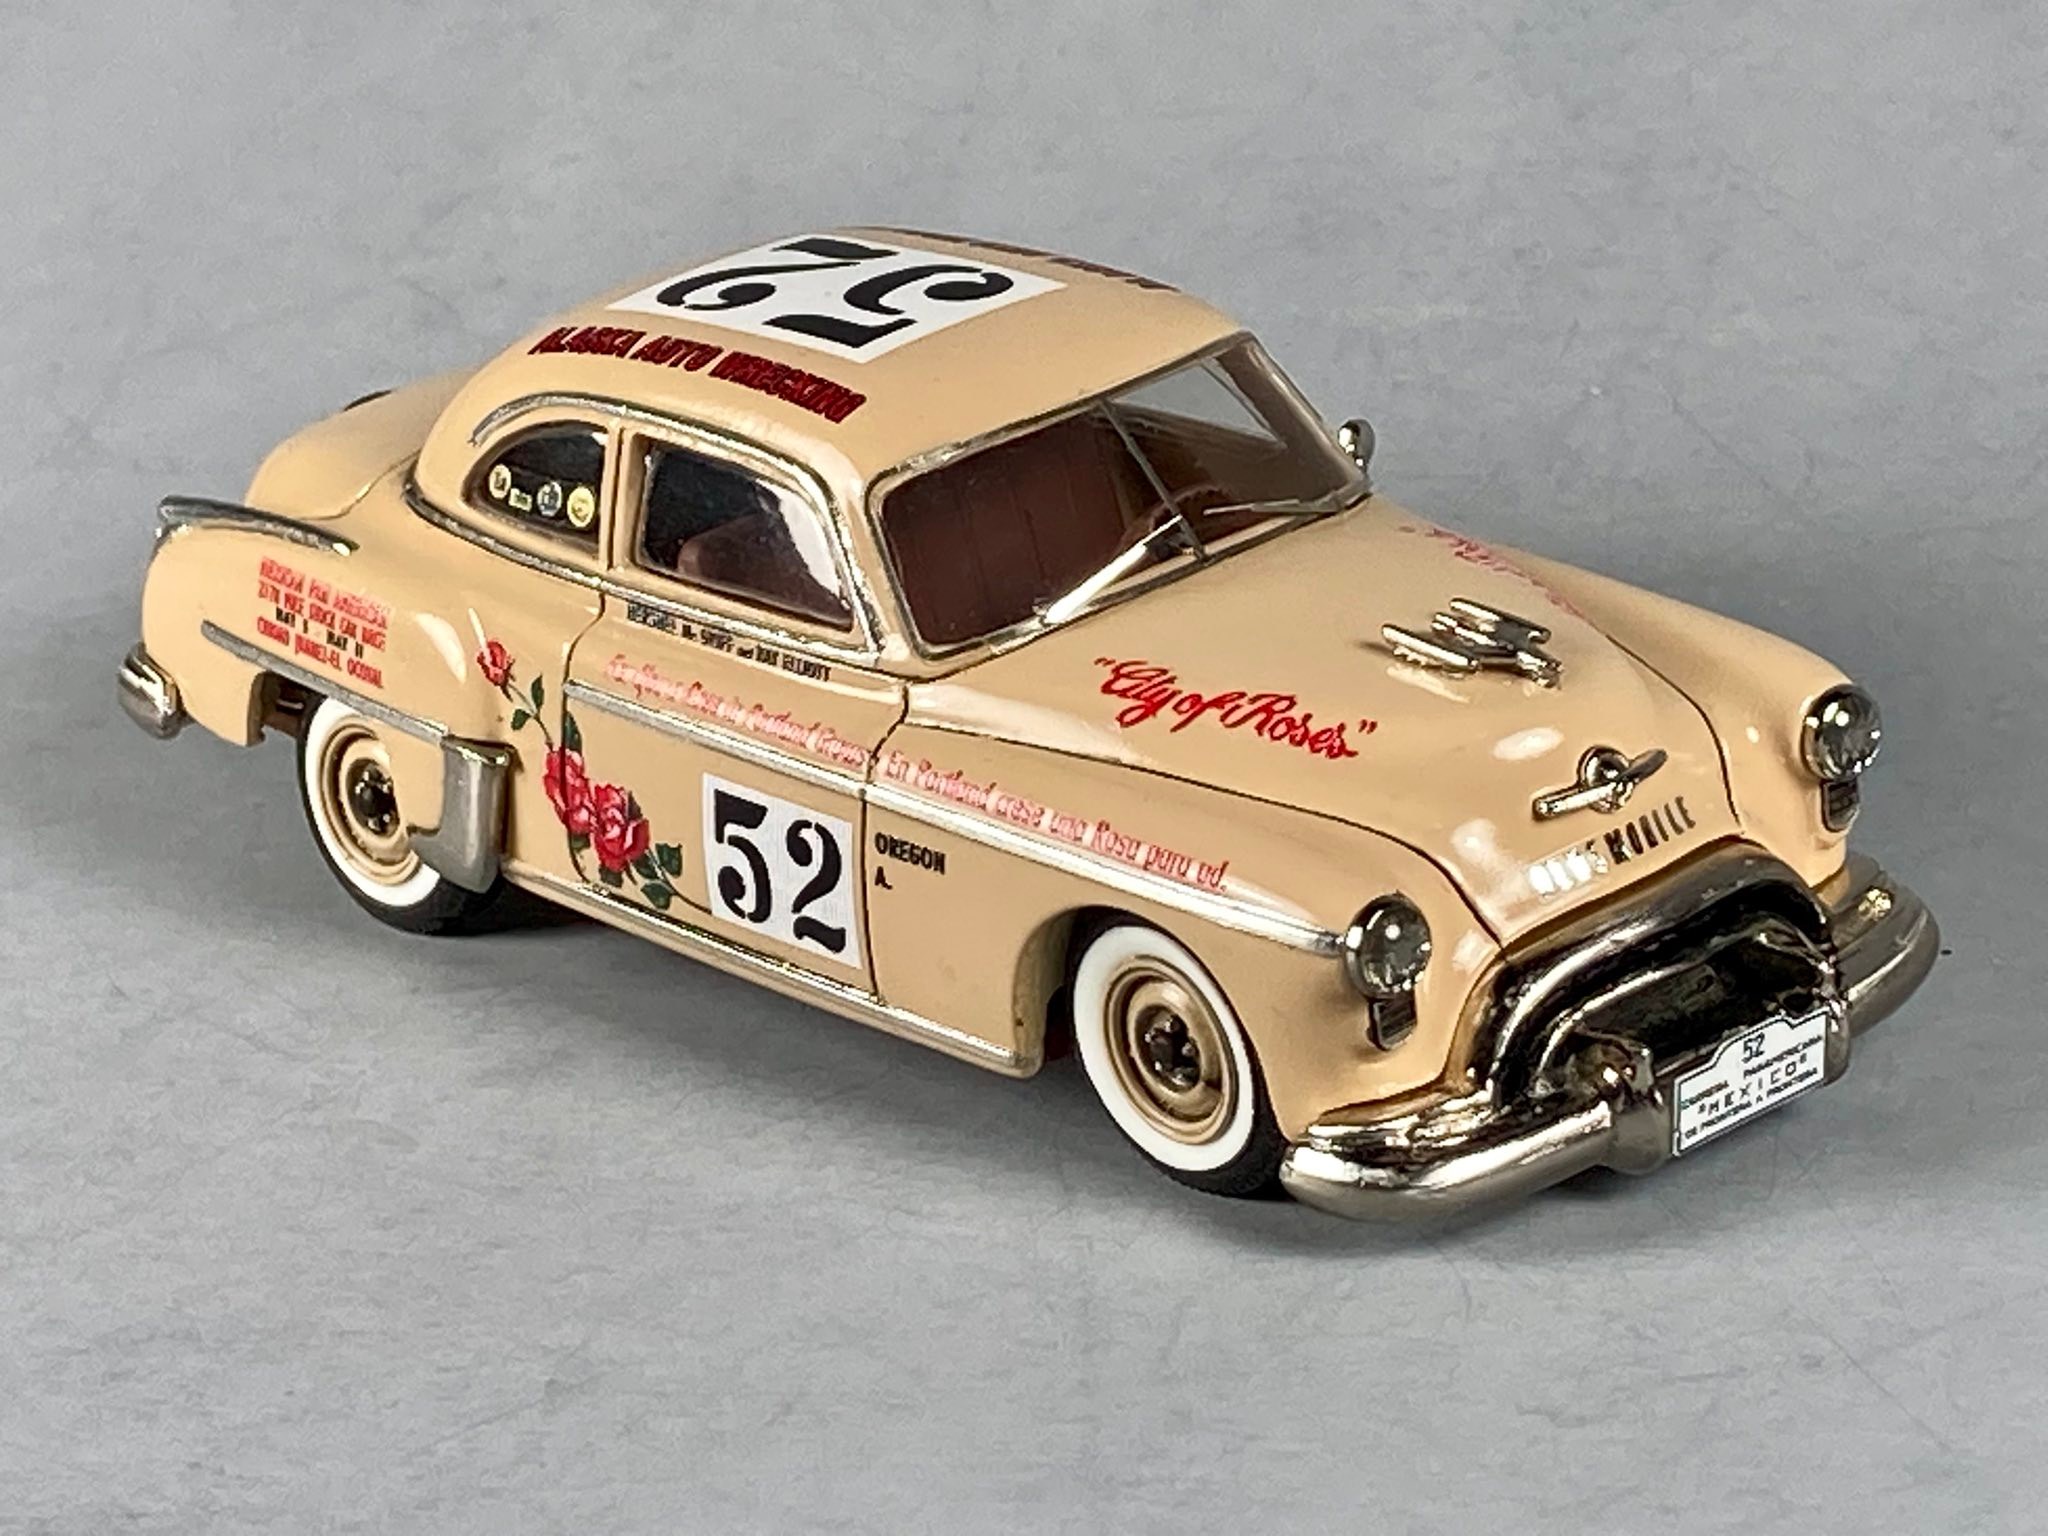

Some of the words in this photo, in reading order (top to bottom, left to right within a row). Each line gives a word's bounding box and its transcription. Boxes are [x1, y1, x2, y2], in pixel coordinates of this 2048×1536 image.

[629, 335, 725, 373] AUTO
[714, 788, 847, 954] 52
[874, 832, 946, 875] OREGON
[1142, 844, 1193, 877] para
[1741, 1031, 1766, 1063] 52
